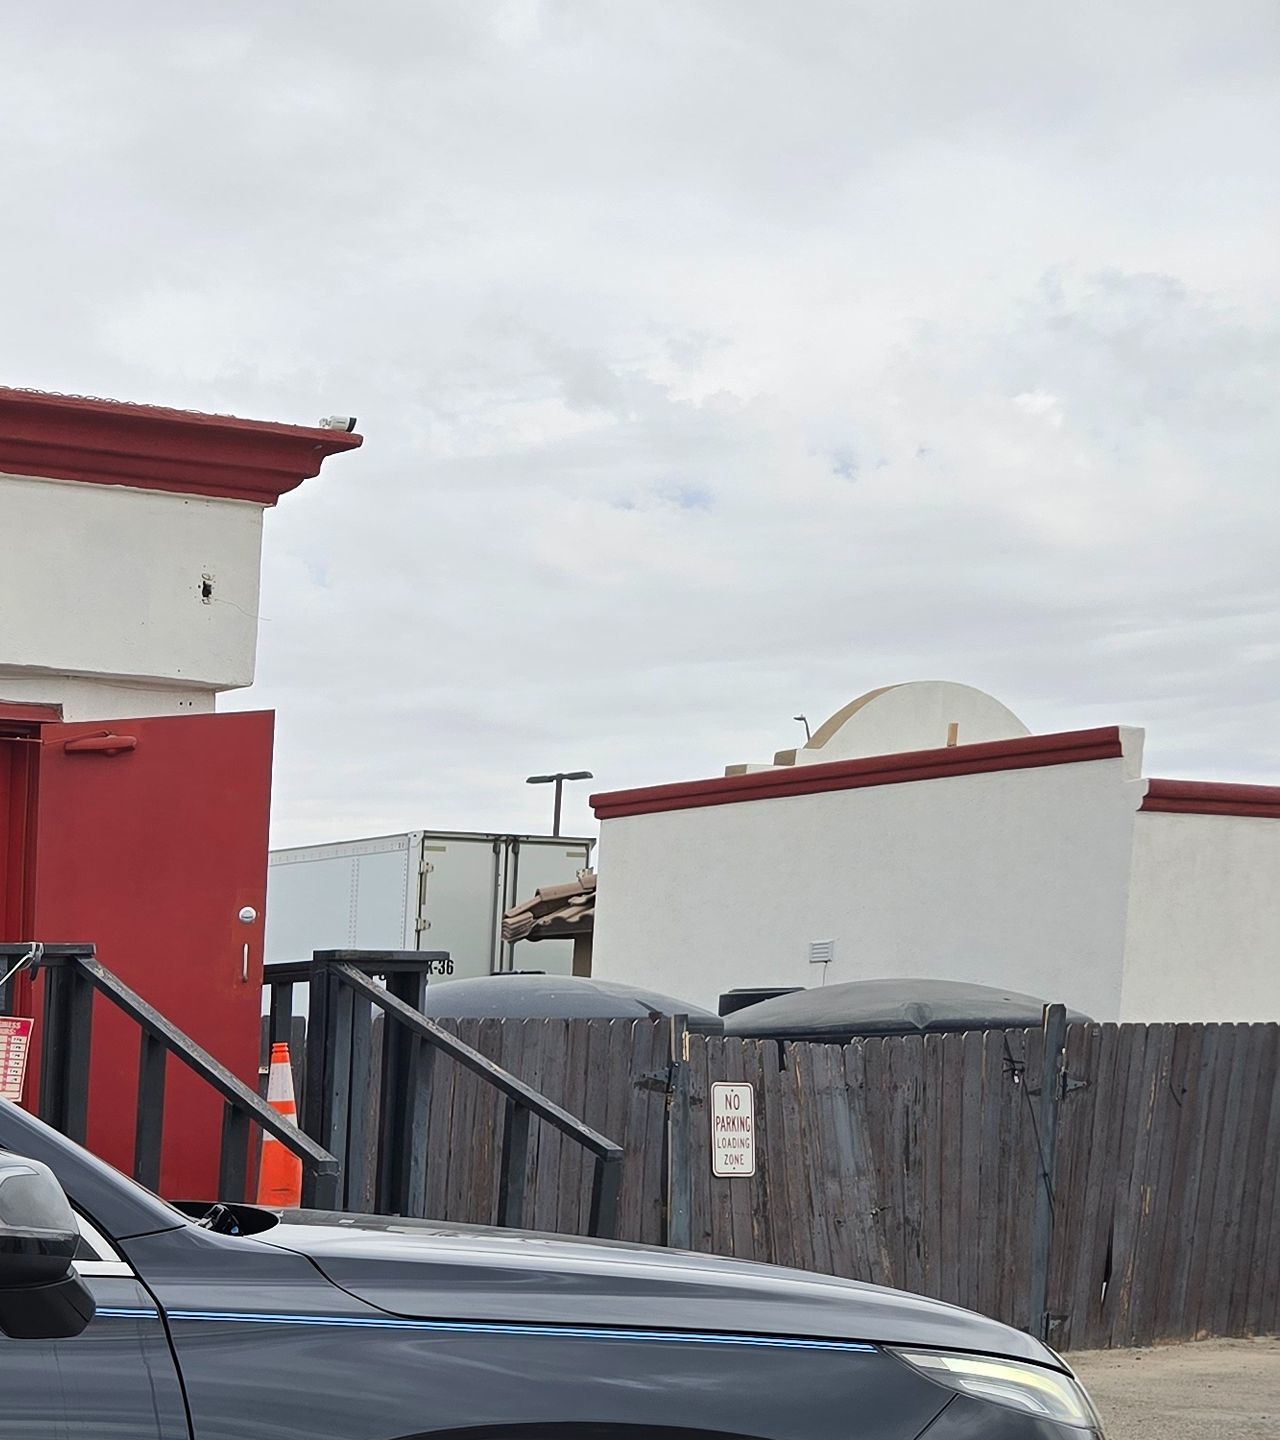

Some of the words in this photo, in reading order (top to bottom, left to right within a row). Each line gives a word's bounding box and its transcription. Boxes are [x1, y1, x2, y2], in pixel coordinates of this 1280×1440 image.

[725, 1094, 740, 1110] NO
[716, 1116, 751, 1132] PARKING
[717, 1138, 750, 1149] LOADING
[724, 1154, 745, 1166] ZONE
